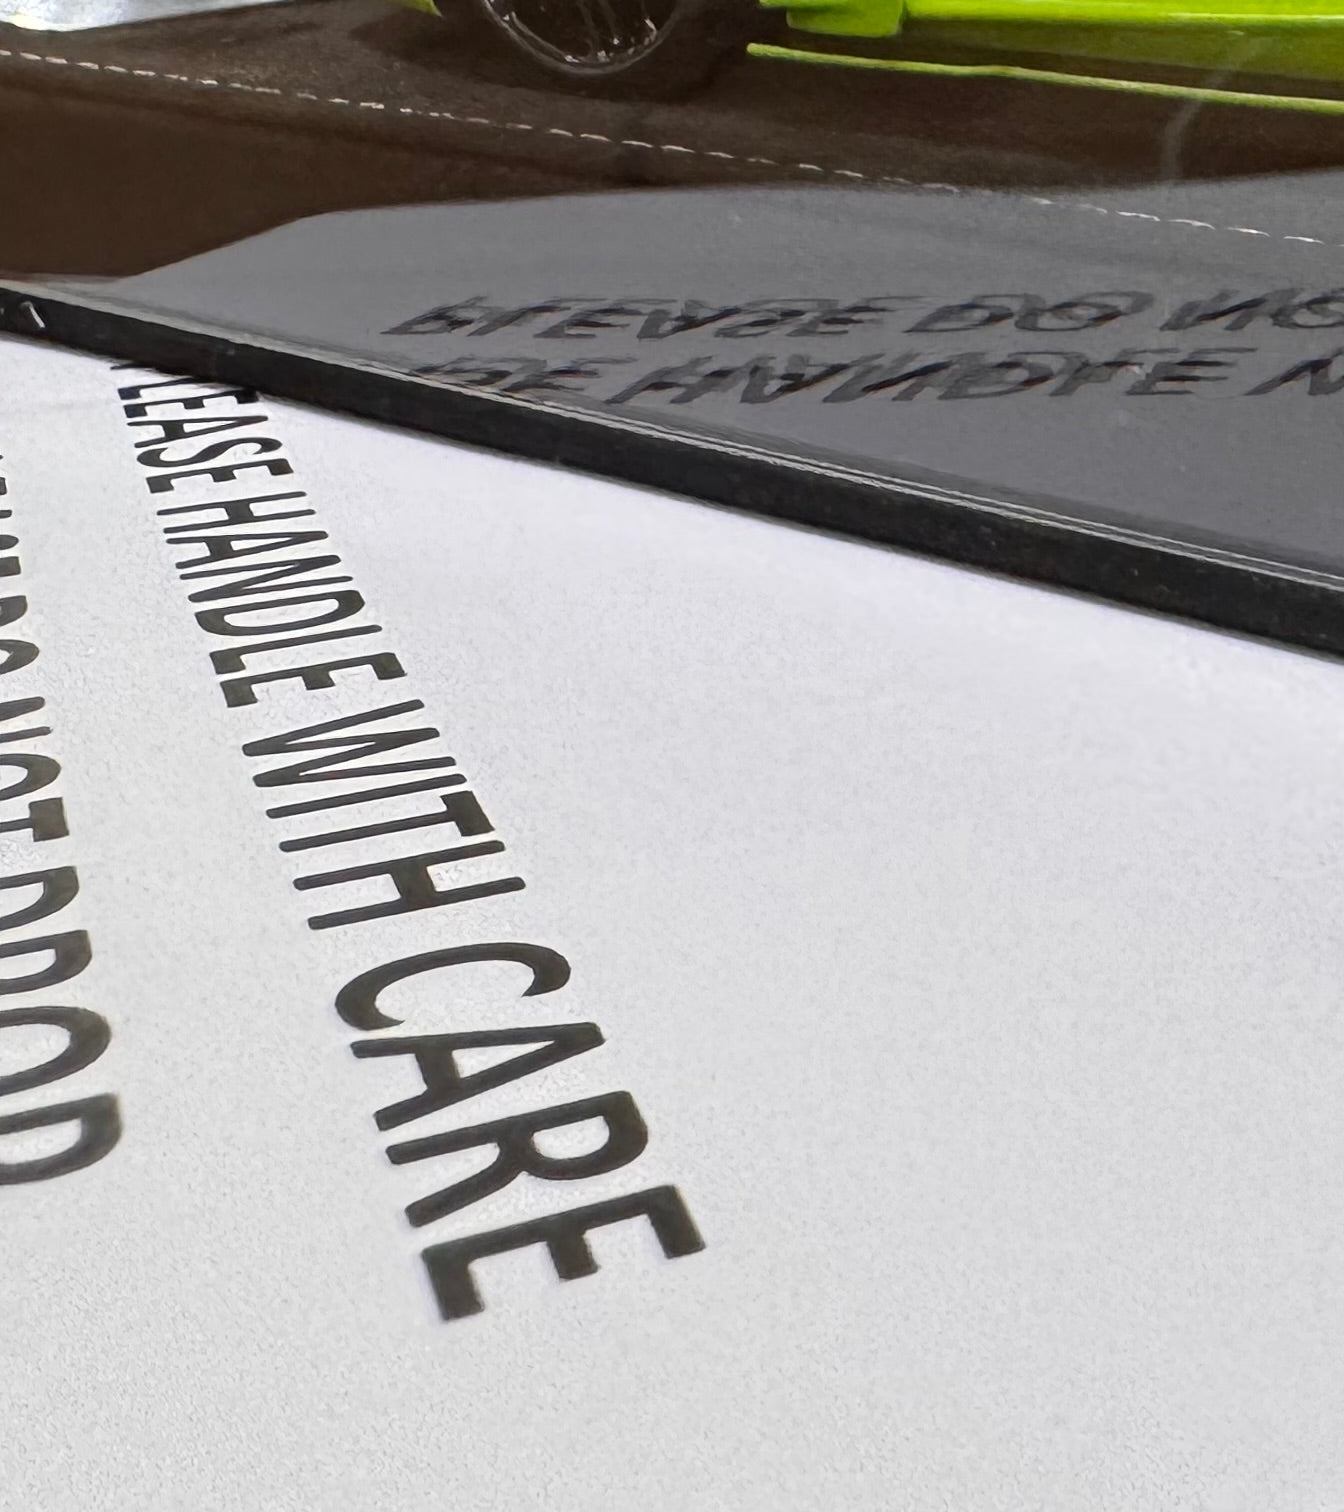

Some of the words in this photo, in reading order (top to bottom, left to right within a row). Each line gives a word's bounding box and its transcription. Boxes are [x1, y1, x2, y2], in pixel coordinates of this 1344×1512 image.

[110, 364, 294, 494] LEASE
[156, 489, 408, 708] HANDLE
[241, 698, 526, 931] WITH
[334, 941, 707, 1321] CARE
